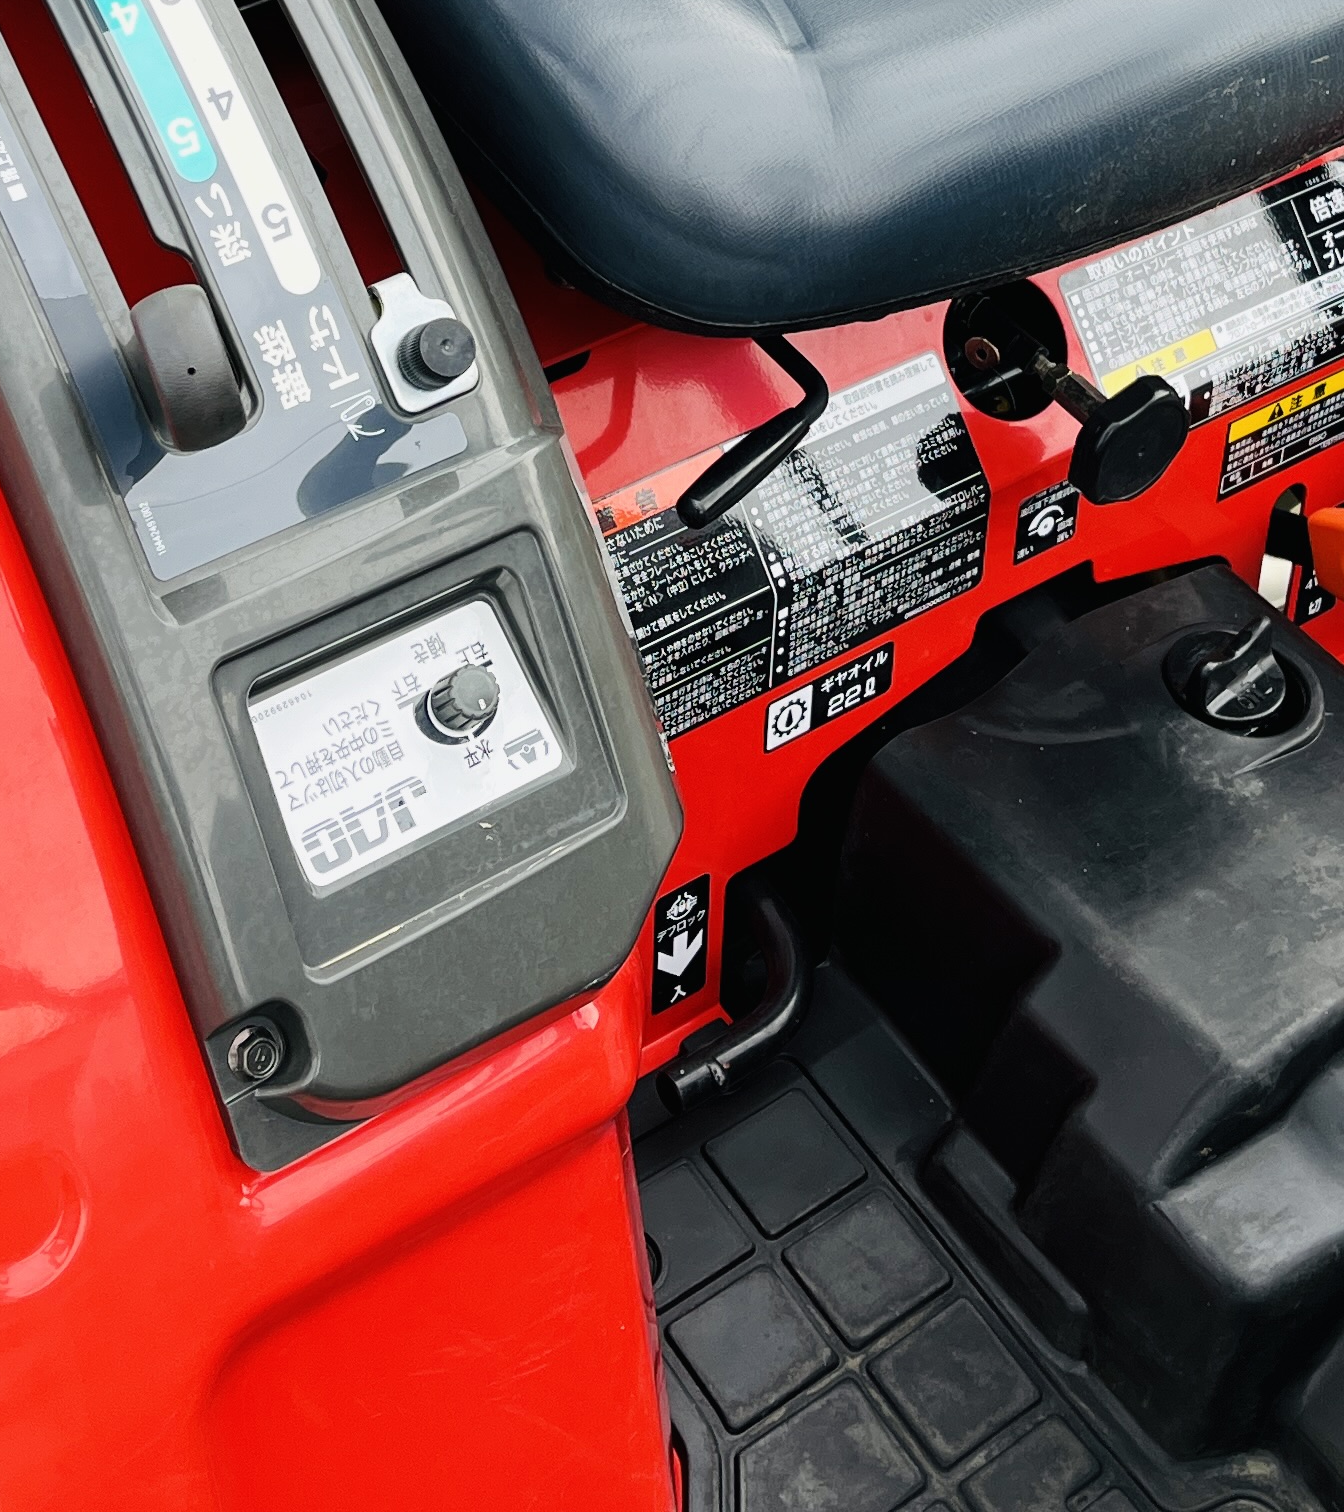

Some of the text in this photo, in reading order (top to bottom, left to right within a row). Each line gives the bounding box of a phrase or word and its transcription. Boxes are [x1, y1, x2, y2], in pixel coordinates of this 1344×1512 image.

[109, 0, 140, 36] 4
[206, 86, 235, 121] 4
[165, 116, 204, 158] 5
[193, 182, 254, 268] 深い
[259, 202, 295, 243] 5
[1085, 222, 1197, 281] 取扱いのポイント
[253, 318, 313, 411] 解除
[307, 303, 362, 392] 下げ
[408, 631, 447, 665] 傾き
[455, 639, 489, 668] 右上
[387, 671, 422, 701] 右下
[818, 649, 890, 694] ギヤオイル
[320, 695, 383, 738] ください
[272, 717, 394, 789] ミの中央を押して
[460, 737, 495, 768] 水平
[283, 738, 405, 812] 自動の入切はツマ
[657, 909, 706, 944] デフロック
[669, 985, 688, 1004] 入
